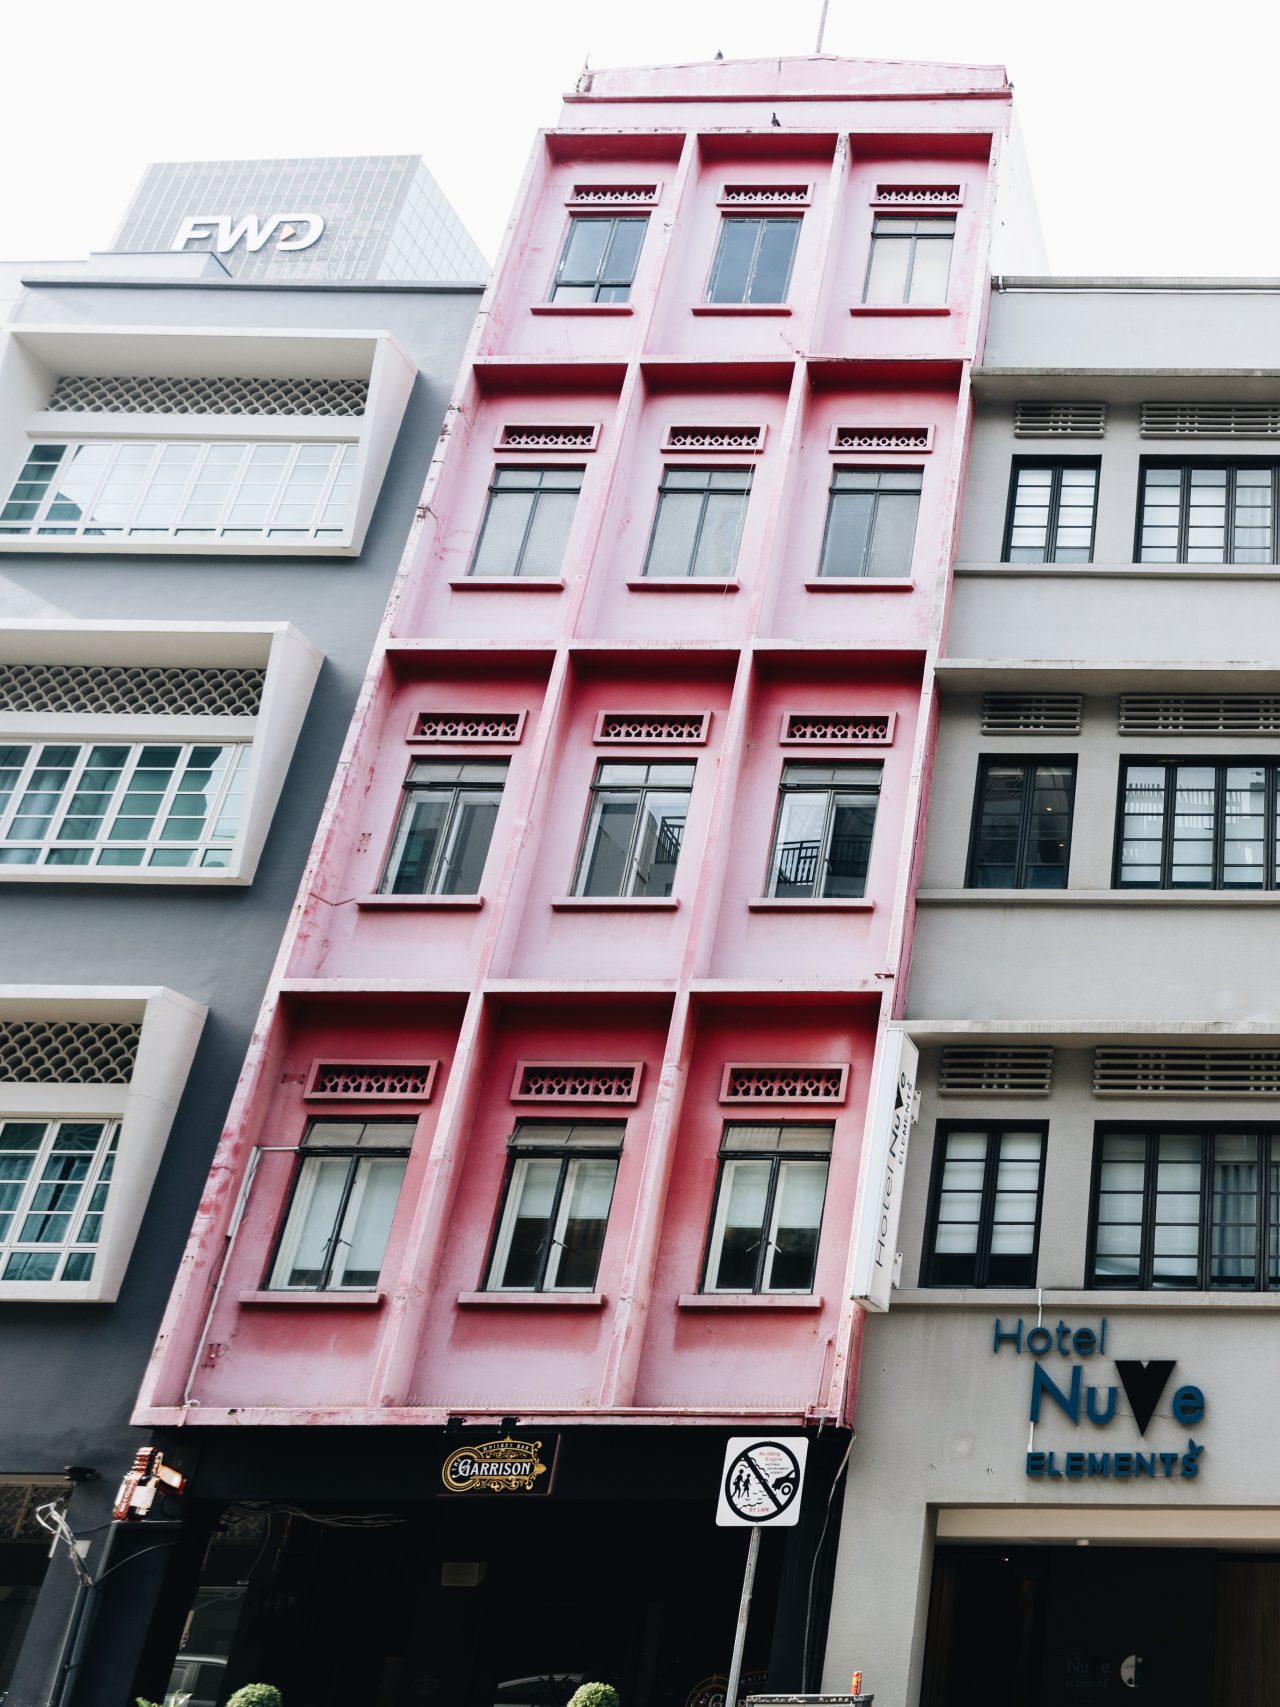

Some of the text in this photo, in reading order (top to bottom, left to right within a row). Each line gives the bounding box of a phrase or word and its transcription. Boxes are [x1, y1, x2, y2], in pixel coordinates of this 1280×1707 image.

[171, 213, 325, 253] FWD
[898, 1081, 914, 1165] ELEMENTS
[876, 1164, 895, 1267] Hotel
[994, 1317, 1108, 1356] Hotel
[452, 1457, 462, 1471] THE
[482, 1443, 530, 1452] WHISKEY BAR
[453, 1458, 531, 1477] GARRISON
[1026, 1451, 1201, 1478] ELEMENTS
